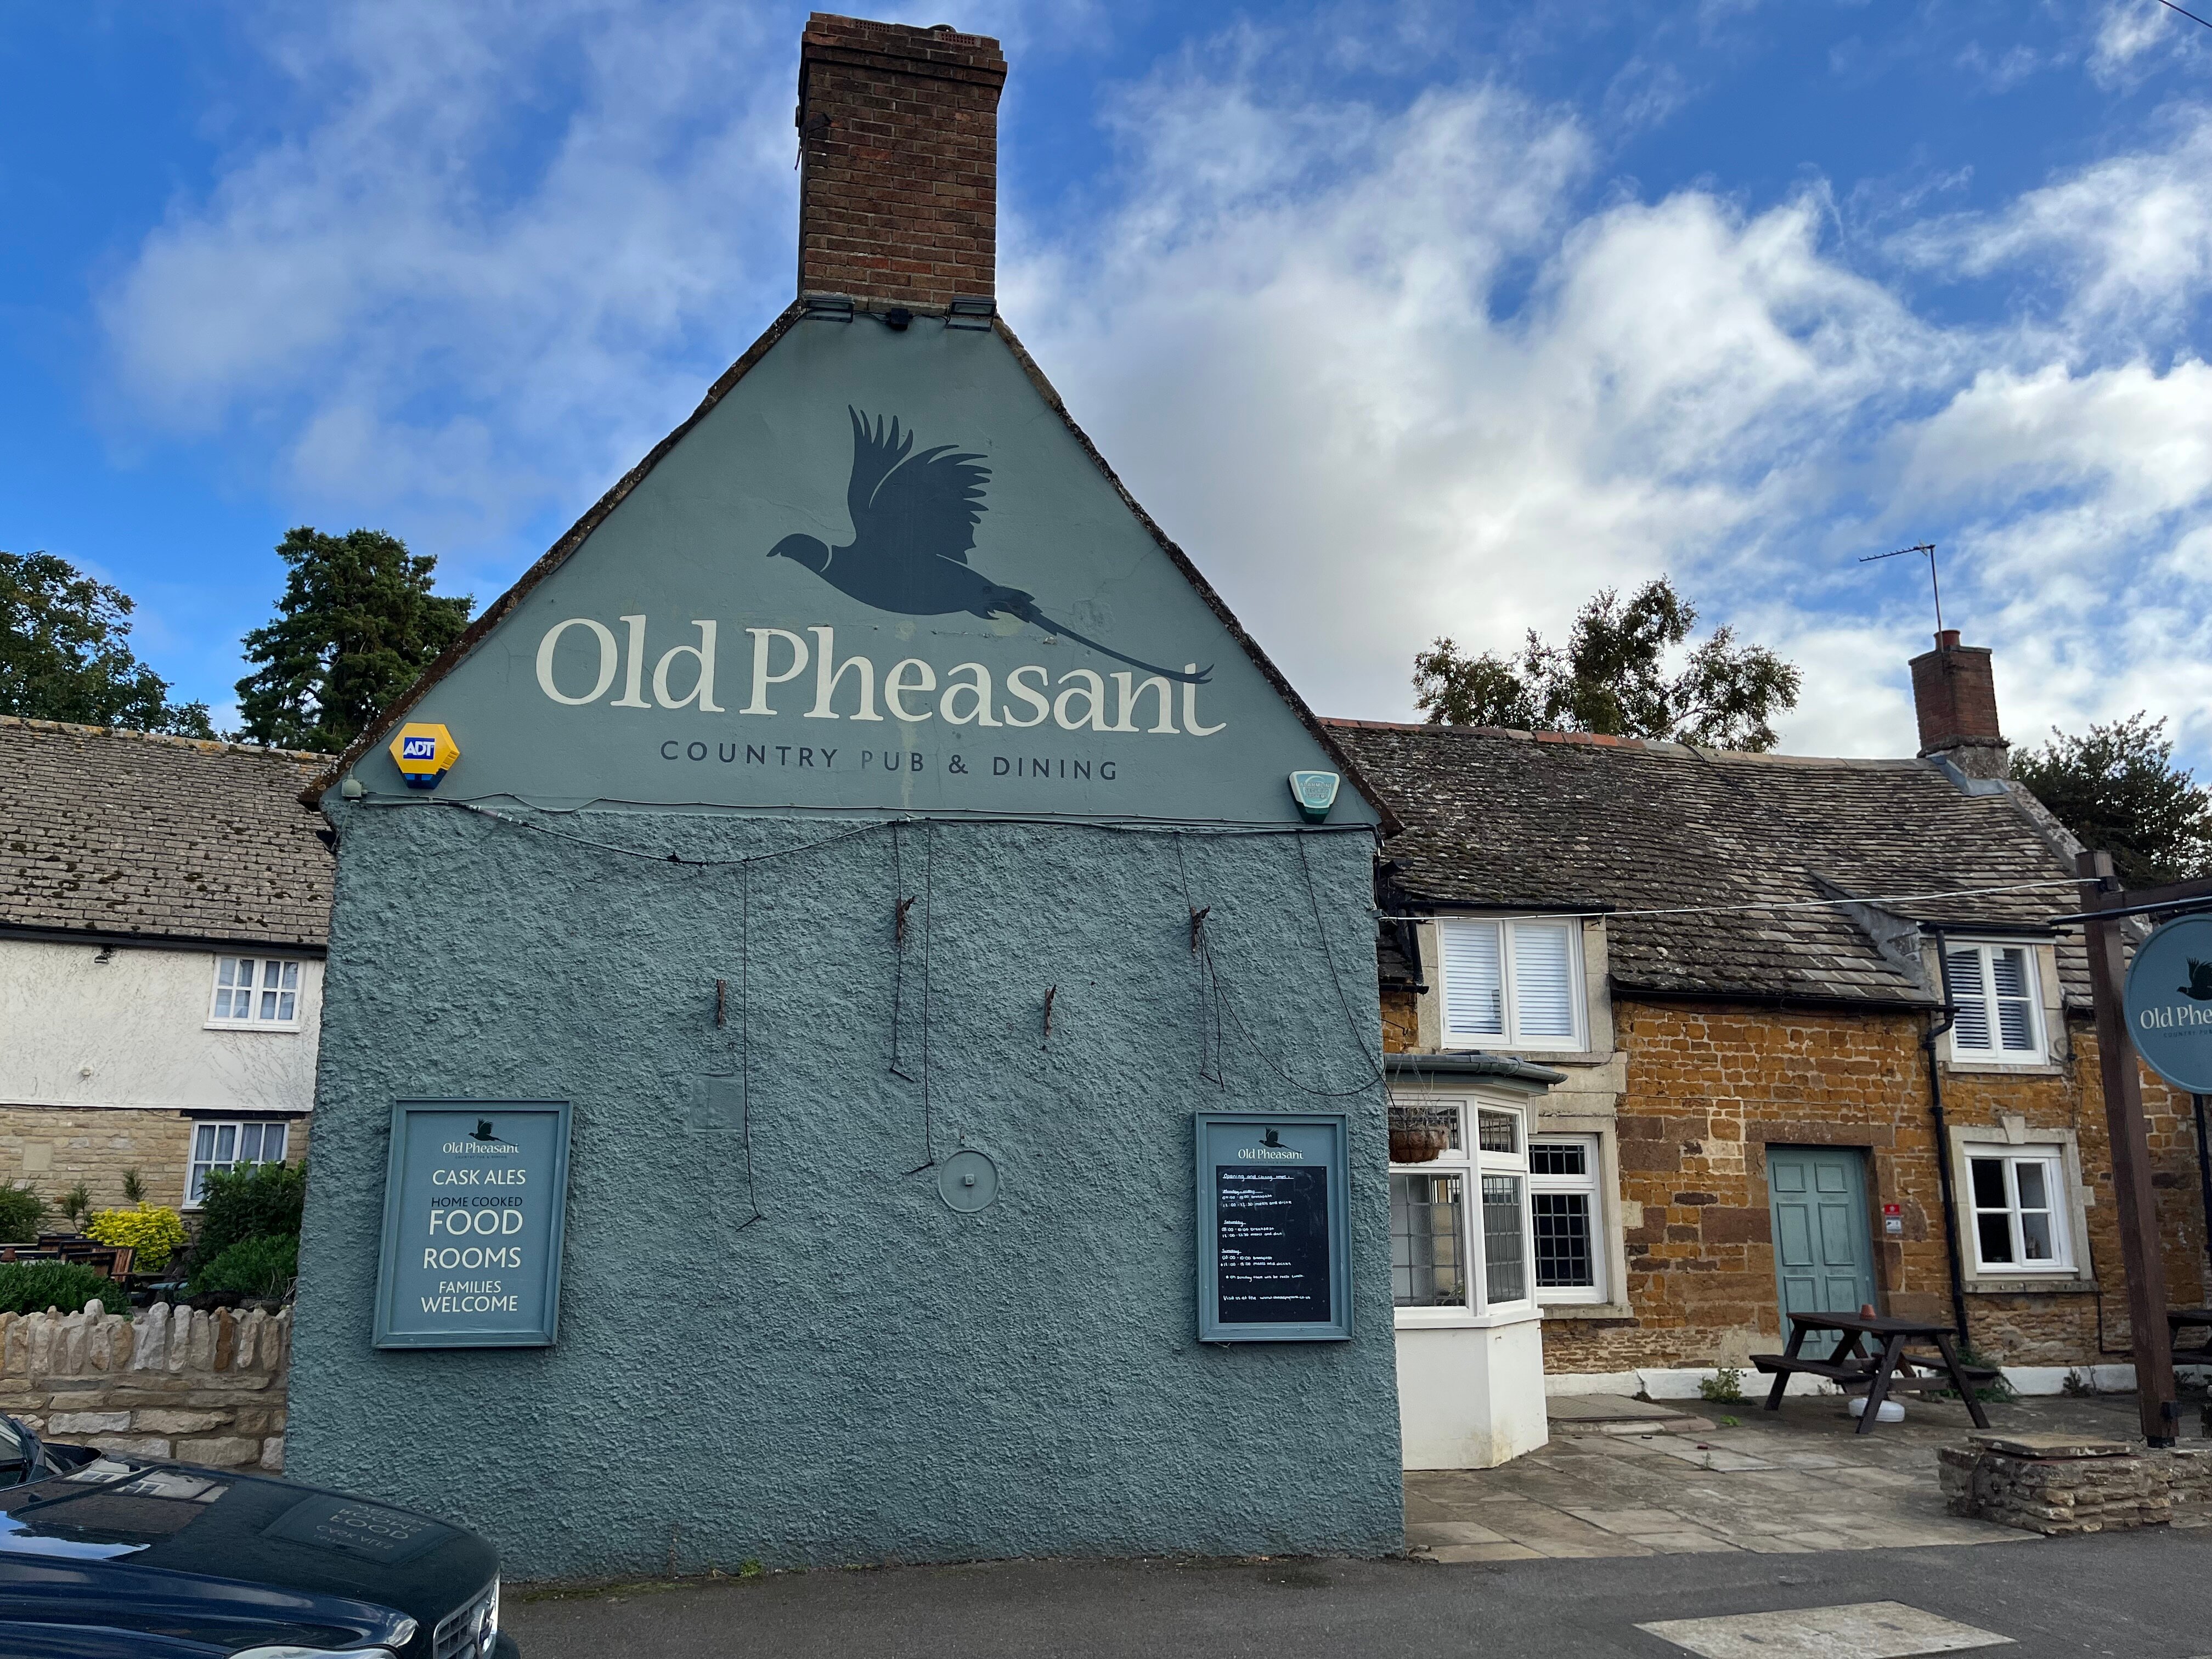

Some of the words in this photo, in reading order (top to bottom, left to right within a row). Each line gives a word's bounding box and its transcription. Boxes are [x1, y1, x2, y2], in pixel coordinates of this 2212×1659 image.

[535, 614, 725, 713] Old
[739, 626, 1227, 736] Pheasant
[403, 741, 435, 756] ADT
[661, 740, 838, 768] COUNTRY
[862, 750, 924, 772] PUB
[948, 754, 968, 774] &
[993, 757, 1116, 781] DINING
[2141, 1006, 2173, 1029] Old
[443, 1142, 462, 1153] Old
[465, 1142, 520, 1154] Pheasant
[1238, 1148, 1255, 1159] Old
[1257, 1148, 1304, 1159] Pheasant
[432, 1169, 480, 1185] CASK
[484, 1169, 526, 1185] ALES
[431, 1197, 468, 1207] HOME
[472, 1197, 523, 1206] COOKED
[429, 1209, 523, 1235] FOOD
[423, 1247, 521, 1269] ROOMS
[439, 1280, 501, 1294] FAMILIES
[420, 1296, 518, 1313] WELCOME
